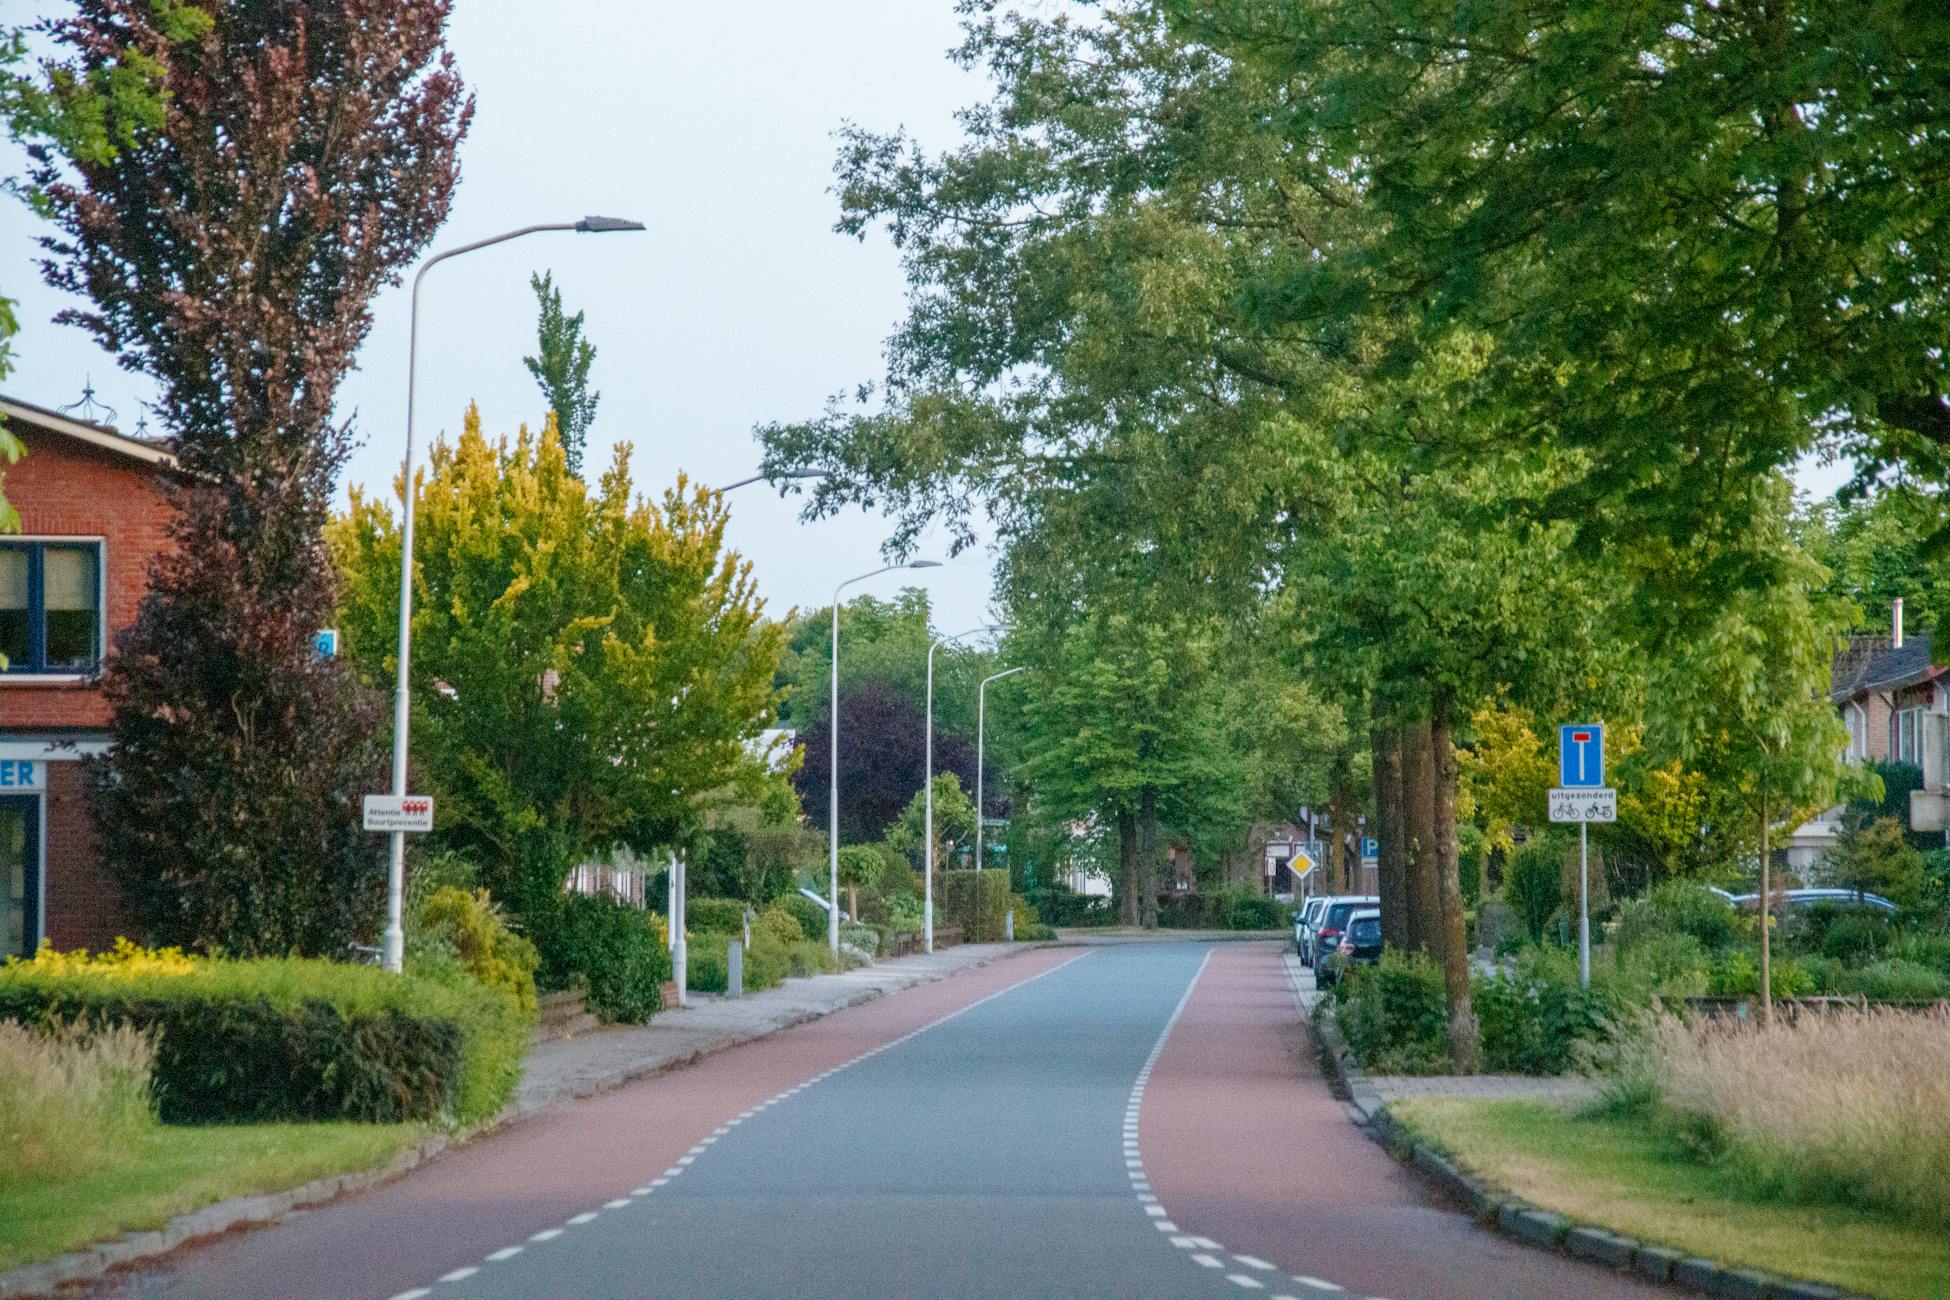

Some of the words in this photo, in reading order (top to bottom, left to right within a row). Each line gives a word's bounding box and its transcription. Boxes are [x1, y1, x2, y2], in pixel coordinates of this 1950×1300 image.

[1551, 792, 1614, 800] uitgezonderd
[368, 808, 401, 816] Attentie
[368, 818, 428, 826] Buurtpreventie
[1367, 839, 1379, 856] P
